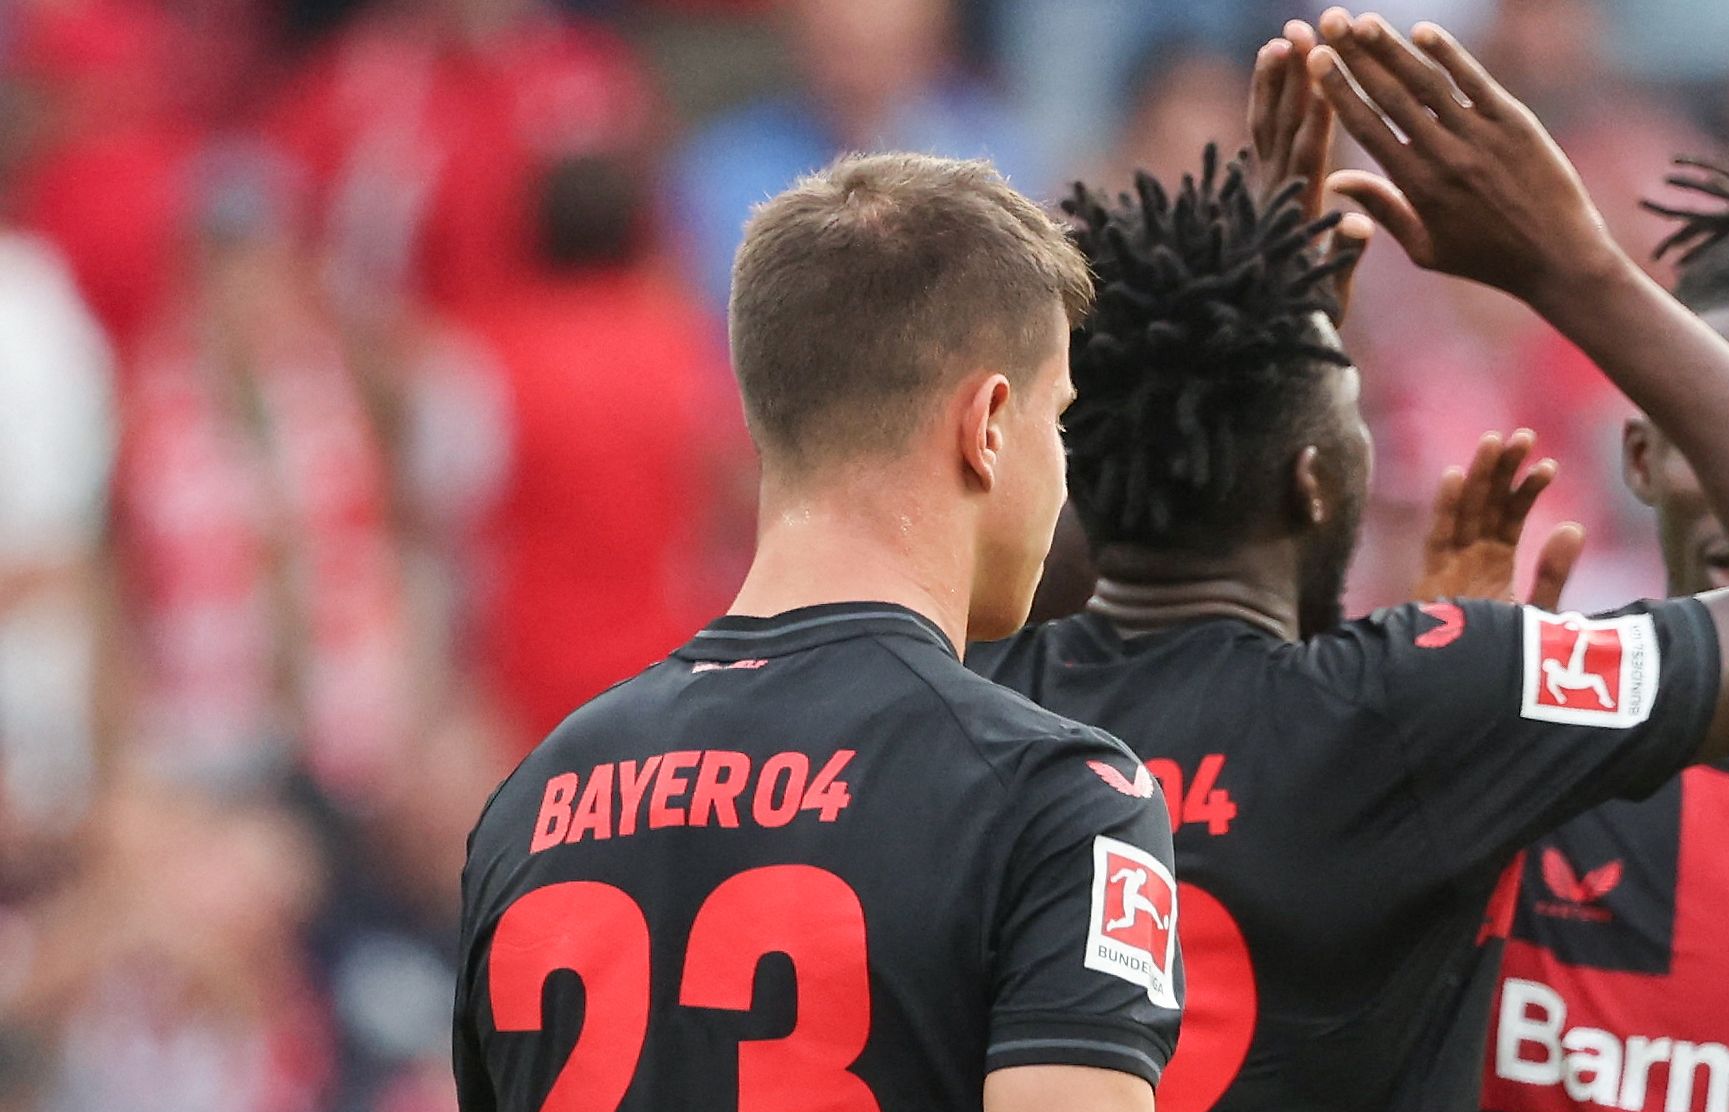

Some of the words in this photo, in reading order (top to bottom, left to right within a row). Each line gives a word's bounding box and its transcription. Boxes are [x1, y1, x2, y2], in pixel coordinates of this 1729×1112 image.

[529, 749, 752, 856] BAYER
[752, 749, 857, 829] 04
[1097, 944, 1165, 995] BUNDEGA
